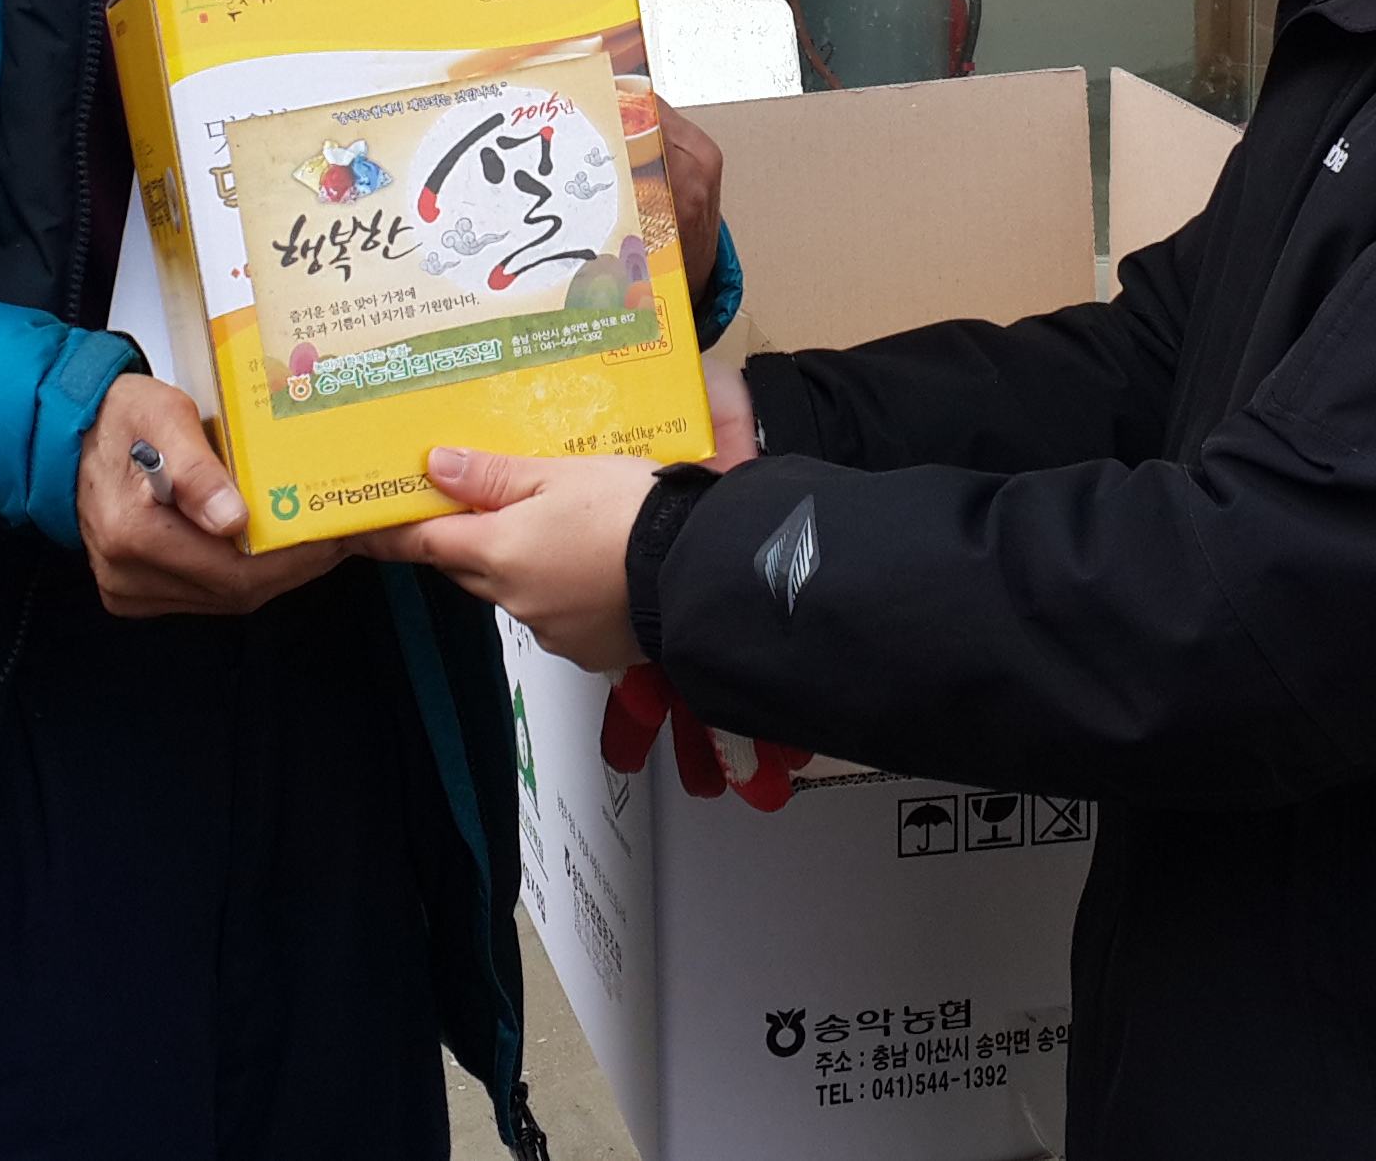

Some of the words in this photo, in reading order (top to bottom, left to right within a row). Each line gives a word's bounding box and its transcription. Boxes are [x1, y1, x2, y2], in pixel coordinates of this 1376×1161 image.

[510, 90, 575, 127] 2015년
[417, 112, 598, 291] 설
[271, 208, 424, 283] 행복한
[289, 305, 325, 323] 즐거운
[328, 301, 352, 317] 설을
[354, 294, 379, 310] 맞아
[381, 286, 417, 305] 가정에
[291, 323, 329, 340] 웃음과
[331, 313, 367, 331] 기쁨이
[369, 303, 417, 326] 넘치기를
[419, 292, 480, 315] 기원합니다.
[511, 333, 529, 346] 충남
[532, 328, 560, 341] 아산시
[562, 322, 589, 336] 송악면
[591, 316, 618, 331] 송악로
[540, 331, 603, 351] 041-544-1392
[315, 338, 503, 395] 송악농업협동조합
[308, 472, 437, 512] 송악농업협동조
[813, 998, 972, 1044] 송악농협
[871, 1042, 909, 1071] 충남
[915, 1034, 970, 1066] 아산시
[975, 1029, 1031, 1060] 송악면
[873, 1064, 1007, 1101] 041)544-1392
